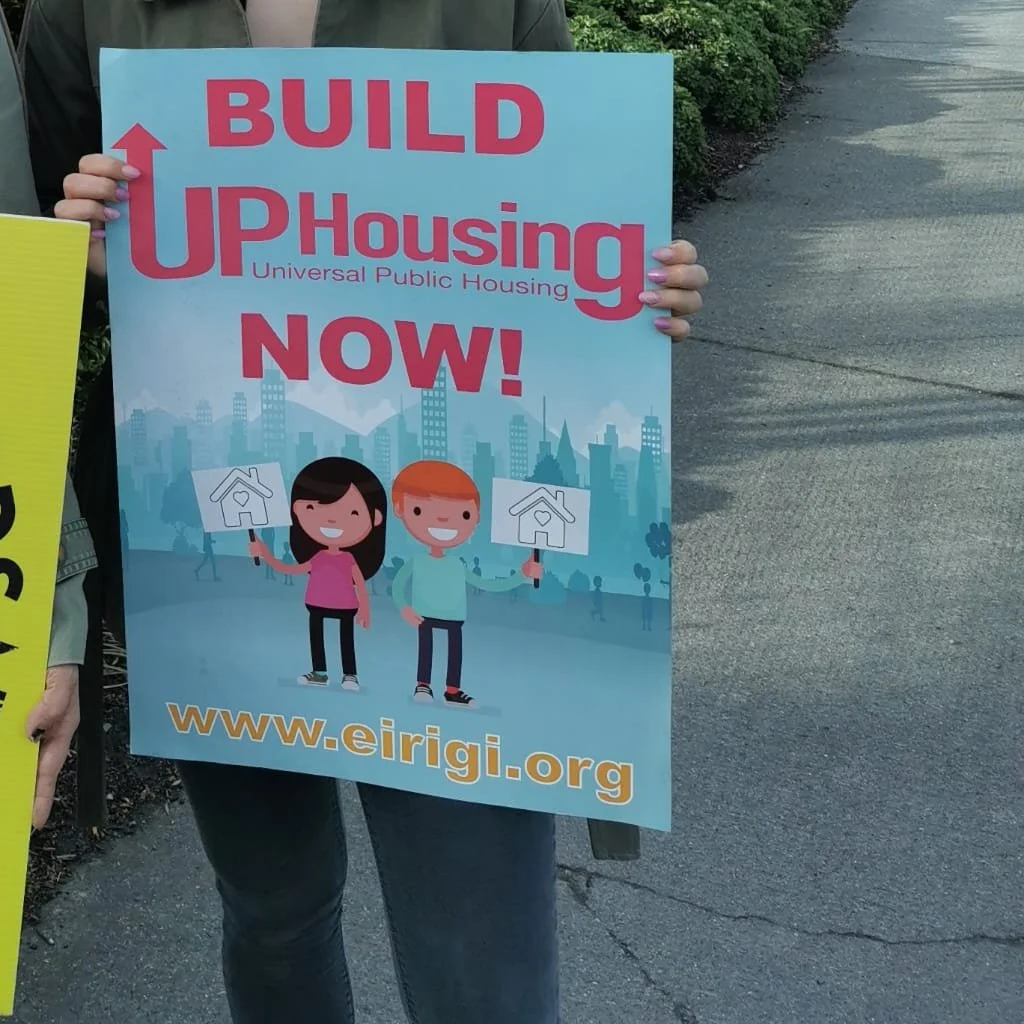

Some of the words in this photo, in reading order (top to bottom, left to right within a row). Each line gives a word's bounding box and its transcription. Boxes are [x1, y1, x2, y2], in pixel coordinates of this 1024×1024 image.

[206, 78, 544, 154] BUILD
[252, 262, 366, 283] Universal
[375, 266, 453, 289] Public
[462, 274, 569, 301] Housing
[241, 312, 523, 397] NOW!
[167, 701, 635, 806] www.eirigi.org
